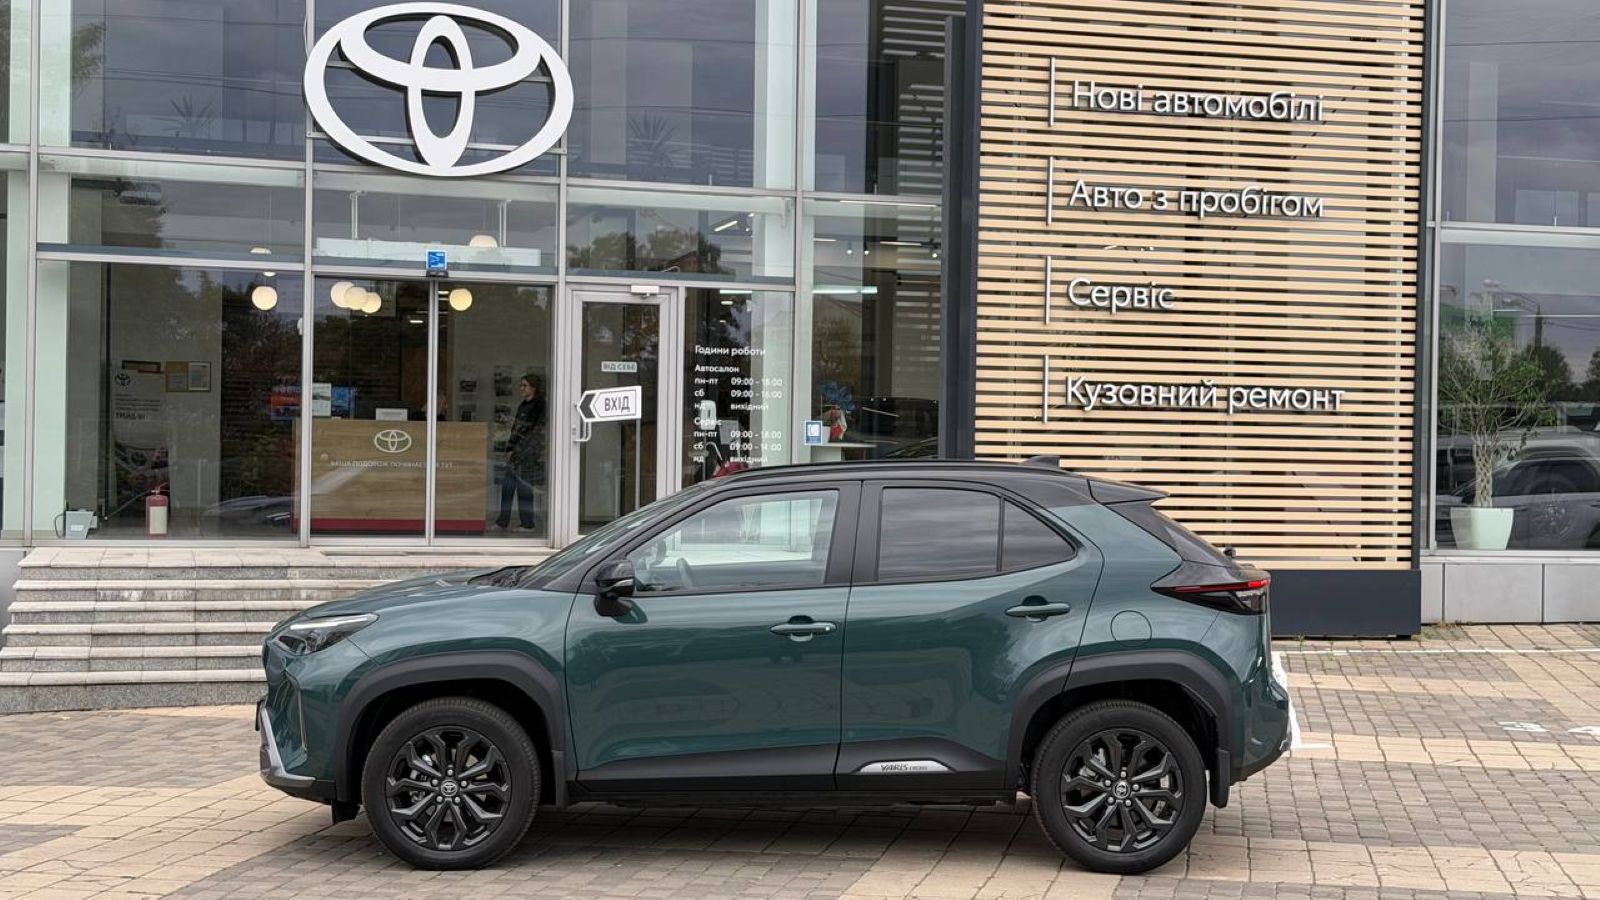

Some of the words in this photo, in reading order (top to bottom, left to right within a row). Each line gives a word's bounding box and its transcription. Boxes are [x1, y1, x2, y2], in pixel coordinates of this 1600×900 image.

[1072, 80, 1144, 112] Нові
[1153, 91, 1324, 121] автомобілі
[1069, 179, 1144, 209] Авто
[1152, 190, 1169, 211] з
[1179, 185, 1325, 220] пробігом
[1067, 277, 1177, 315] Сервіс
[694, 344, 730, 356] Години
[730, 346, 767, 357] роботи
[694, 364, 740, 373] Автосалон
[694, 377, 719, 385] пн-пт
[730, 377, 754, 386] 09:00
[694, 388, 706, 397] сб
[730, 389, 754, 398] 09:00
[1066, 375, 1218, 412] Кузовний
[1228, 386, 1346, 416] ремонт
[604, 396, 631, 413] ВХІД
[693, 430, 718, 439] пн-пт
[730, 430, 753, 439] 09:00
[692, 441, 705, 451] сб
[729, 443, 753, 452] 09:00
